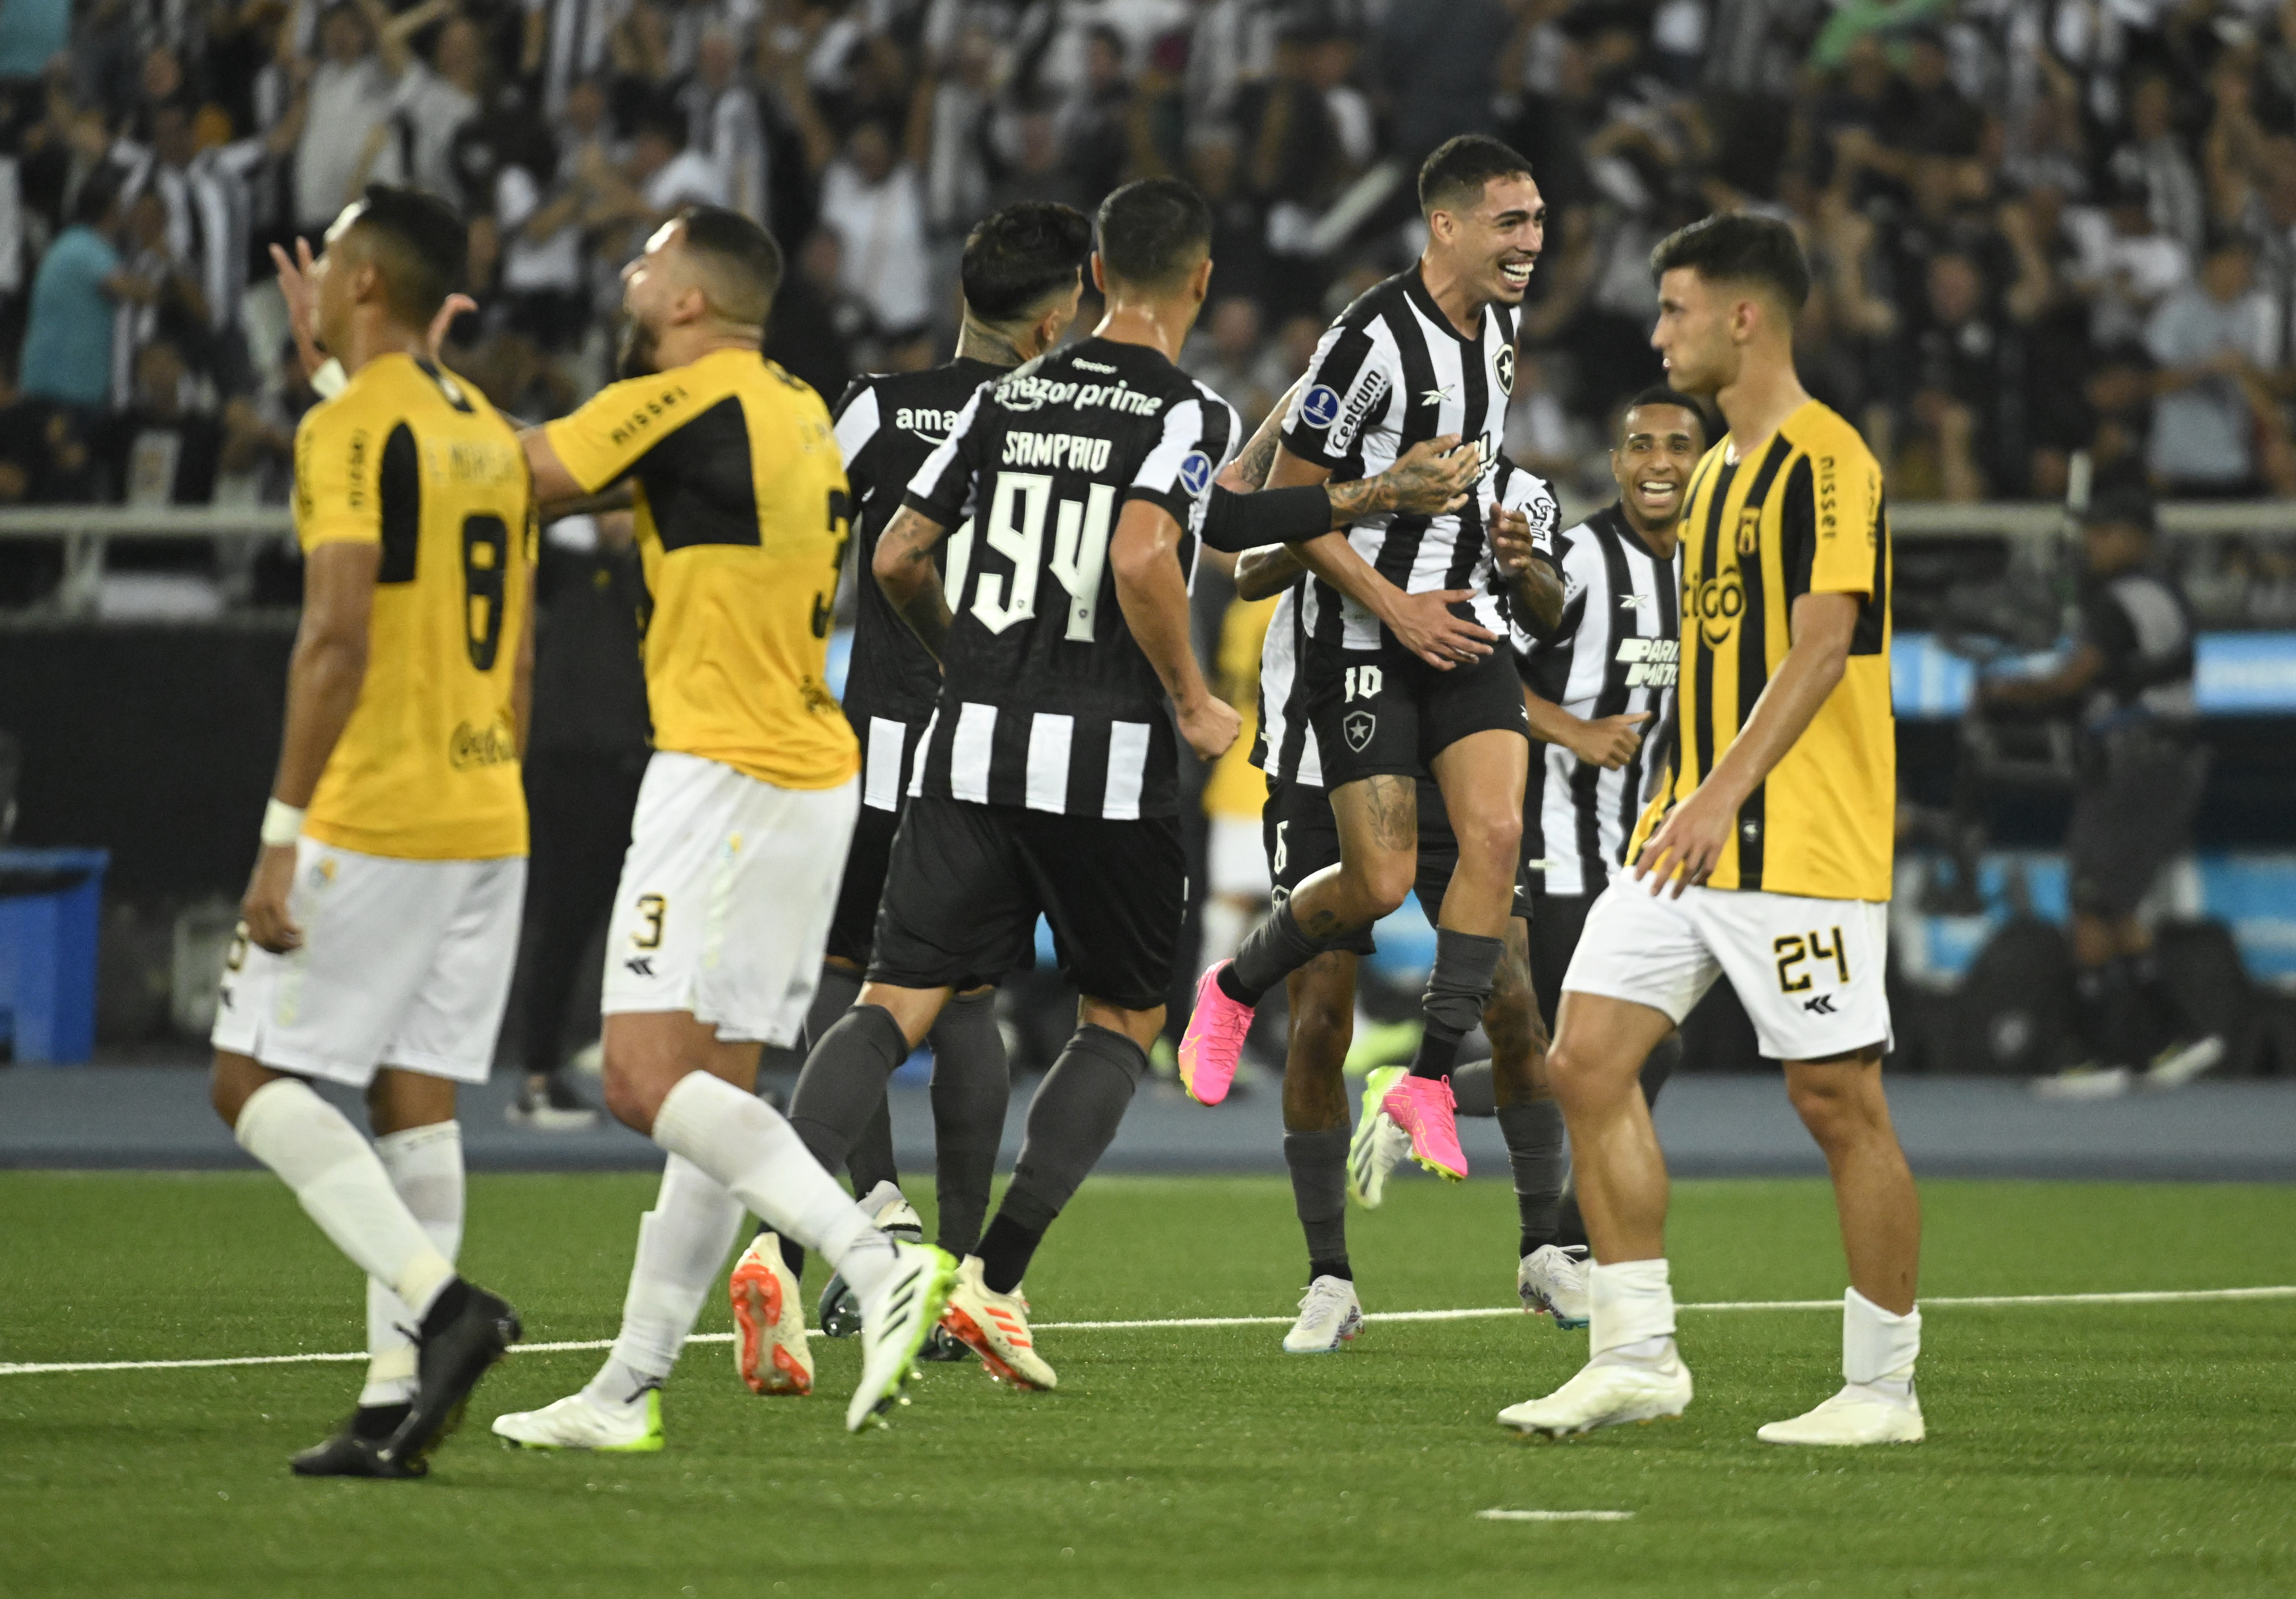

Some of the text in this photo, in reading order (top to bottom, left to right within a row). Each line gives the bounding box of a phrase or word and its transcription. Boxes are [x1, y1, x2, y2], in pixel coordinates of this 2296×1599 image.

[611, 387, 689, 446] nissei
[896, 408, 957, 432] ama
[1074, 379, 1163, 416] prime
[1333, 370, 1381, 449] Centrum
[1002, 430, 1113, 474] SAMPAIO
[1820, 456, 1836, 541] nissei
[970, 471, 1117, 643] 94
[461, 512, 507, 672] 8
[1345, 665, 1383, 703] 10
[1274, 820, 1288, 875] 6
[632, 893, 665, 948] 3
[1774, 926, 1850, 994] 24
